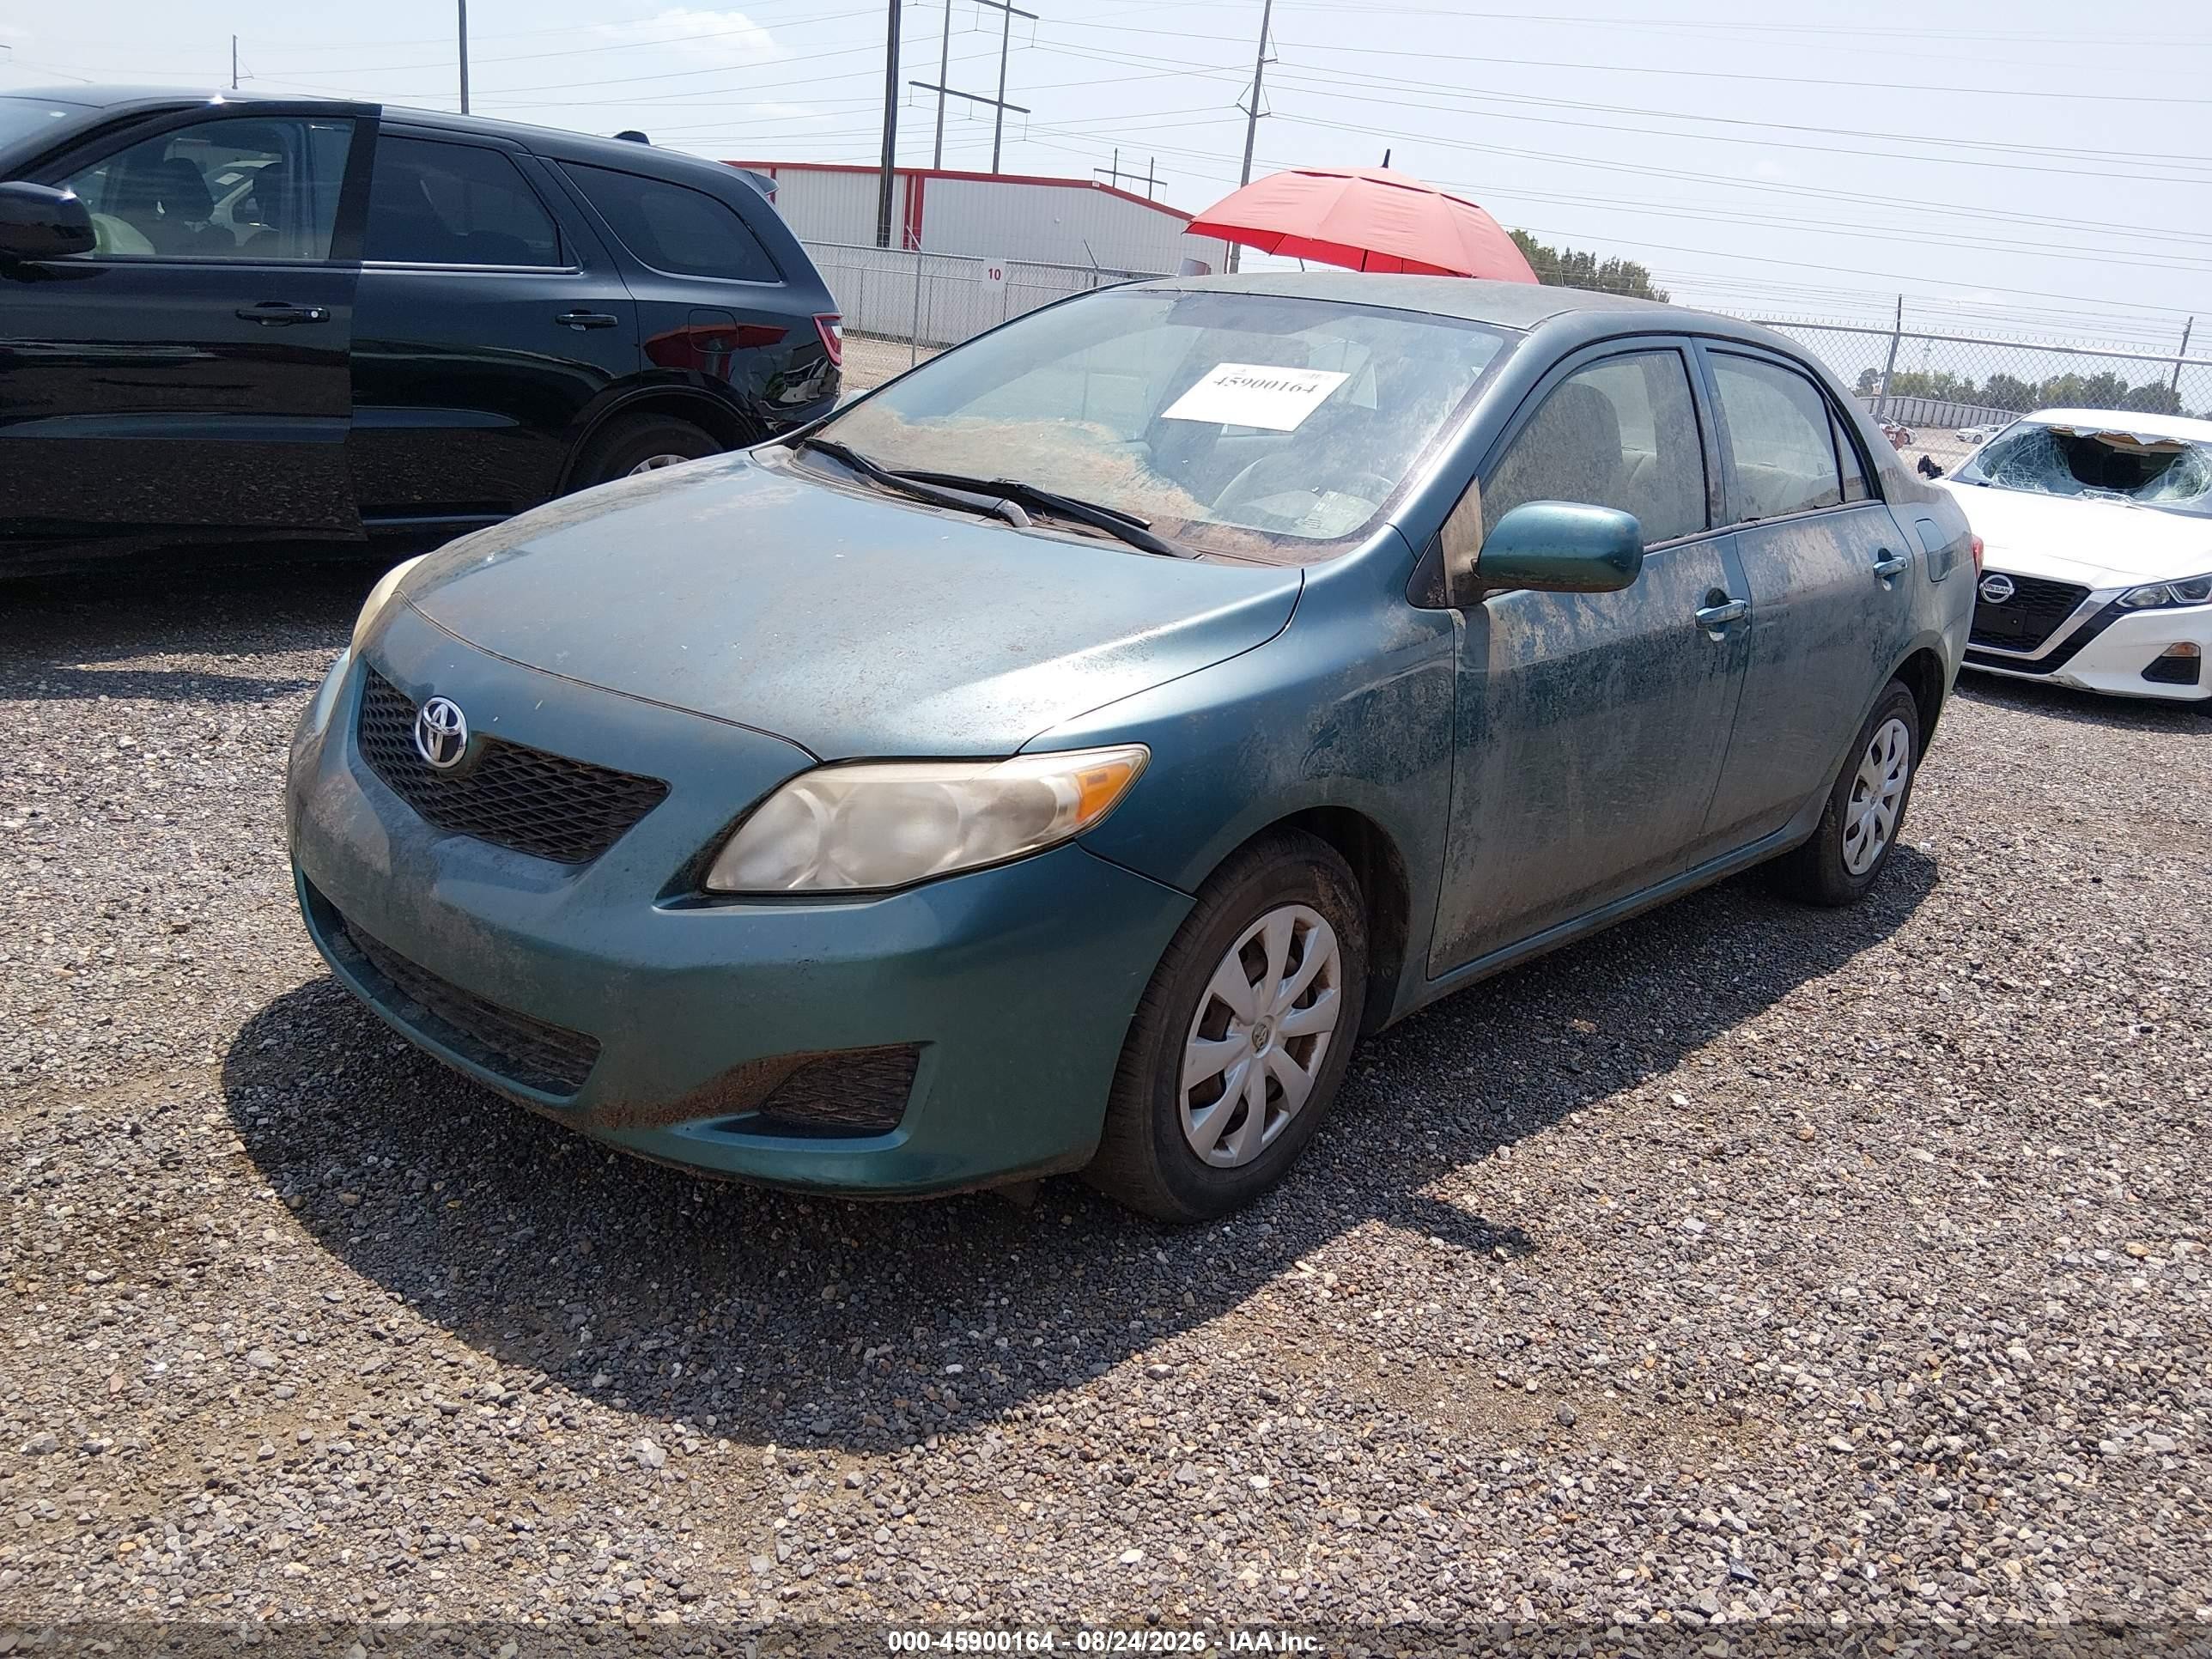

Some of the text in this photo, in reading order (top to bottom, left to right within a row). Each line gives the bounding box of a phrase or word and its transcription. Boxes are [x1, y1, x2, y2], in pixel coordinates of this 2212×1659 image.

[988, 268, 1001, 281] 10
[1212, 376, 1319, 394] 45900164
[1984, 583, 2011, 593] NISSAN
